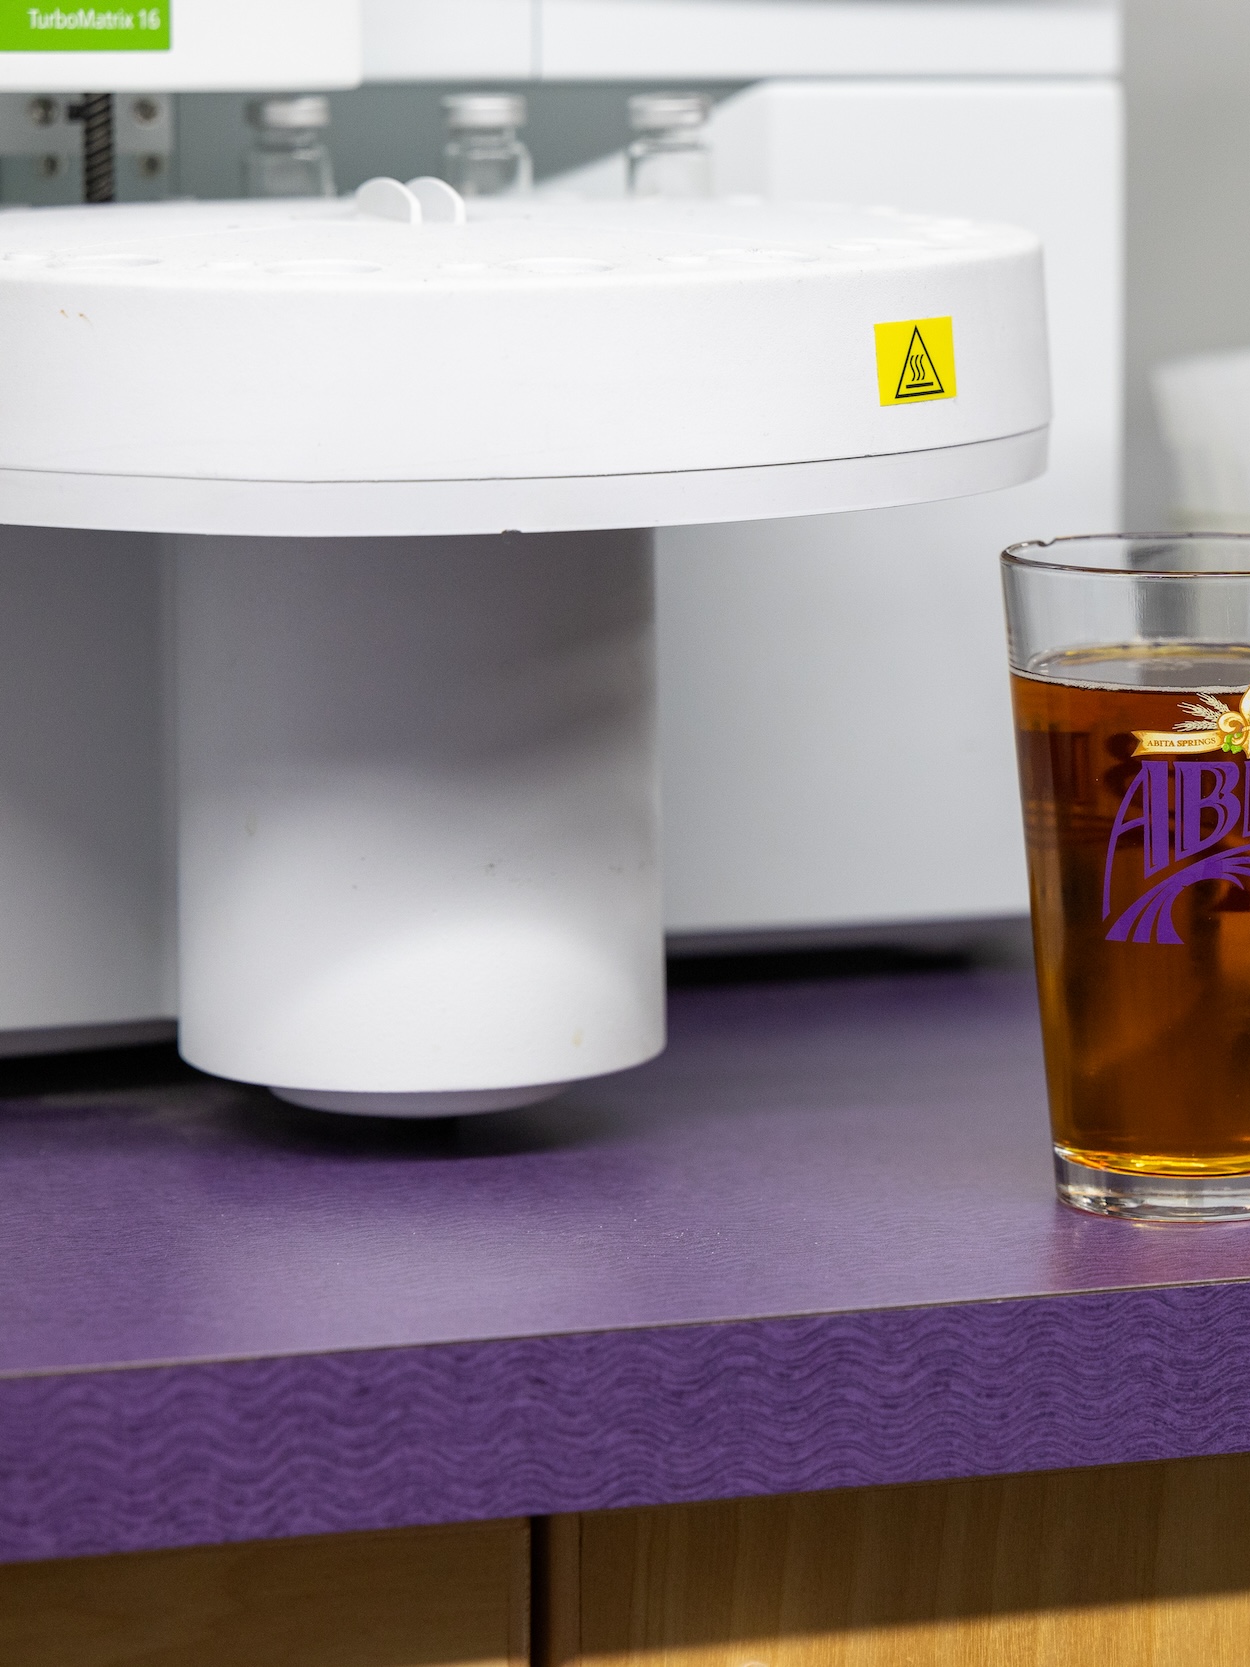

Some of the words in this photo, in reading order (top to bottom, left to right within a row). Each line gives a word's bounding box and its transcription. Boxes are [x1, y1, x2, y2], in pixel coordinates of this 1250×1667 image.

[28, 8, 134, 30] TurboMatrix
[138, 9, 161, 30] 16
[1147, 738, 1175, 747] ABITA
[1176, 737, 1216, 747] SPRINGS
